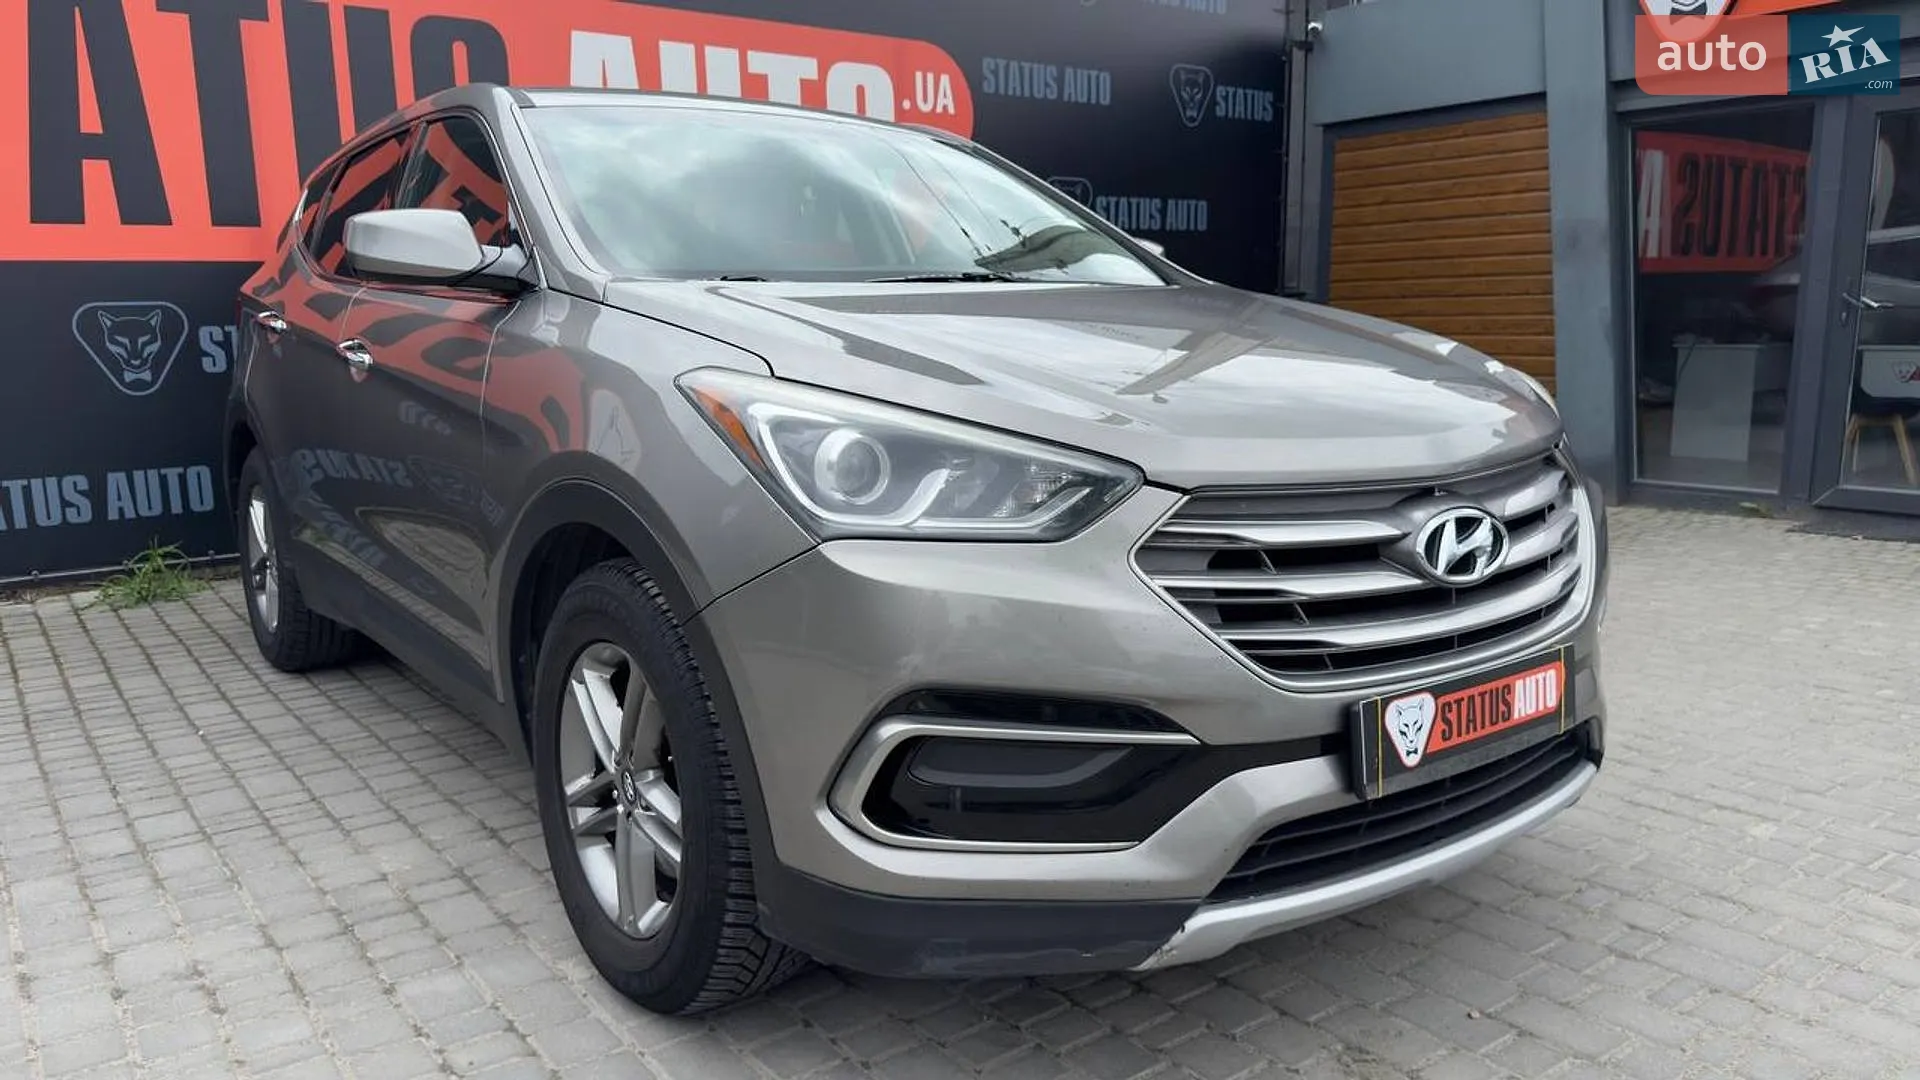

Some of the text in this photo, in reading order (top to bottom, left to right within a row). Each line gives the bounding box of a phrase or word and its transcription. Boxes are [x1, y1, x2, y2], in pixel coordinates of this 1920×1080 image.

[982, 57, 1112, 106] STATUS AUTO
[1215, 85, 1274, 122] STATUS
[1095, 196, 1208, 231] STATUS AUTO
[106, 465, 215, 521] AUTO
[1440, 668, 1558, 742] STATUS AUTO
